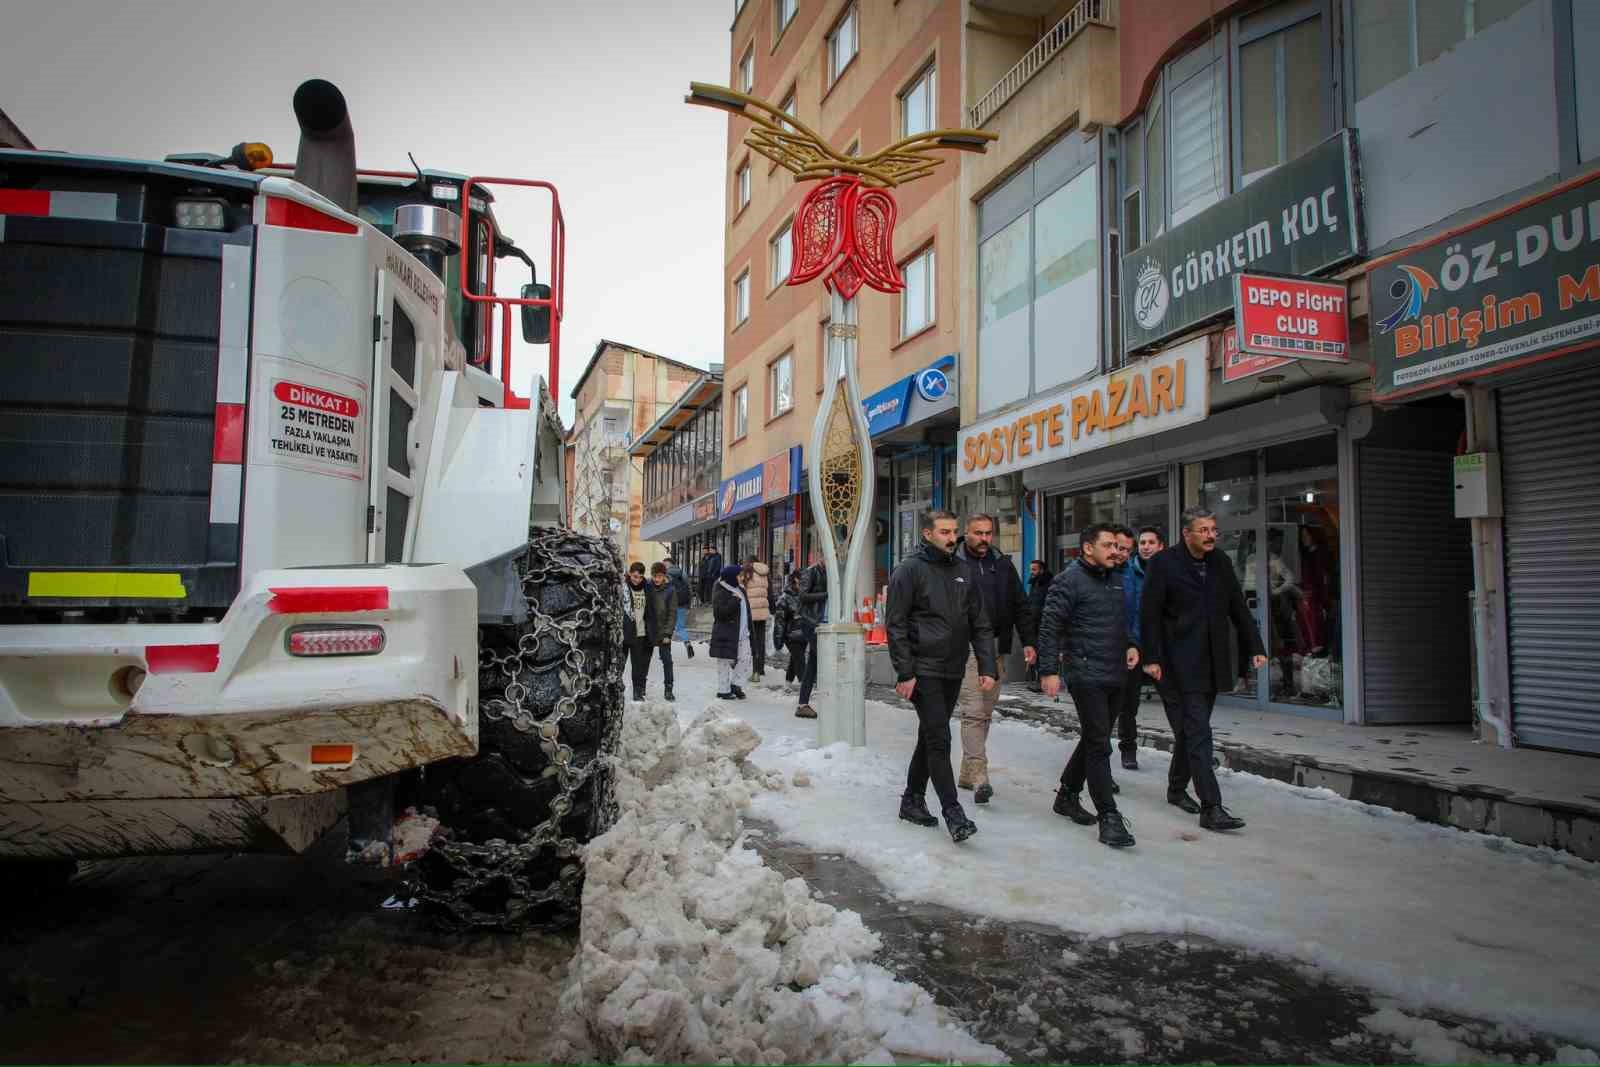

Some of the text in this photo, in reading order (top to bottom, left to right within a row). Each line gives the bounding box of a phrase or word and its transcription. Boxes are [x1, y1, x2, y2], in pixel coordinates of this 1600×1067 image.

[1171, 186, 1338, 298] GÖRKEM KOÇ
[1248, 286, 1291, 308] DEPO
[1276, 316, 1319, 336] CLUB
[1395, 292, 1542, 359] Bilişim
[289, 387, 342, 411] DİKKAT
[281, 406, 355, 434] 25 METREDEN
[963, 358, 1185, 472] SOSYETE PAZARI
[284, 425, 311, 440] FAZLA
[271, 438, 314, 455] TEHLİKELİ
[315, 446, 326, 457] VE
